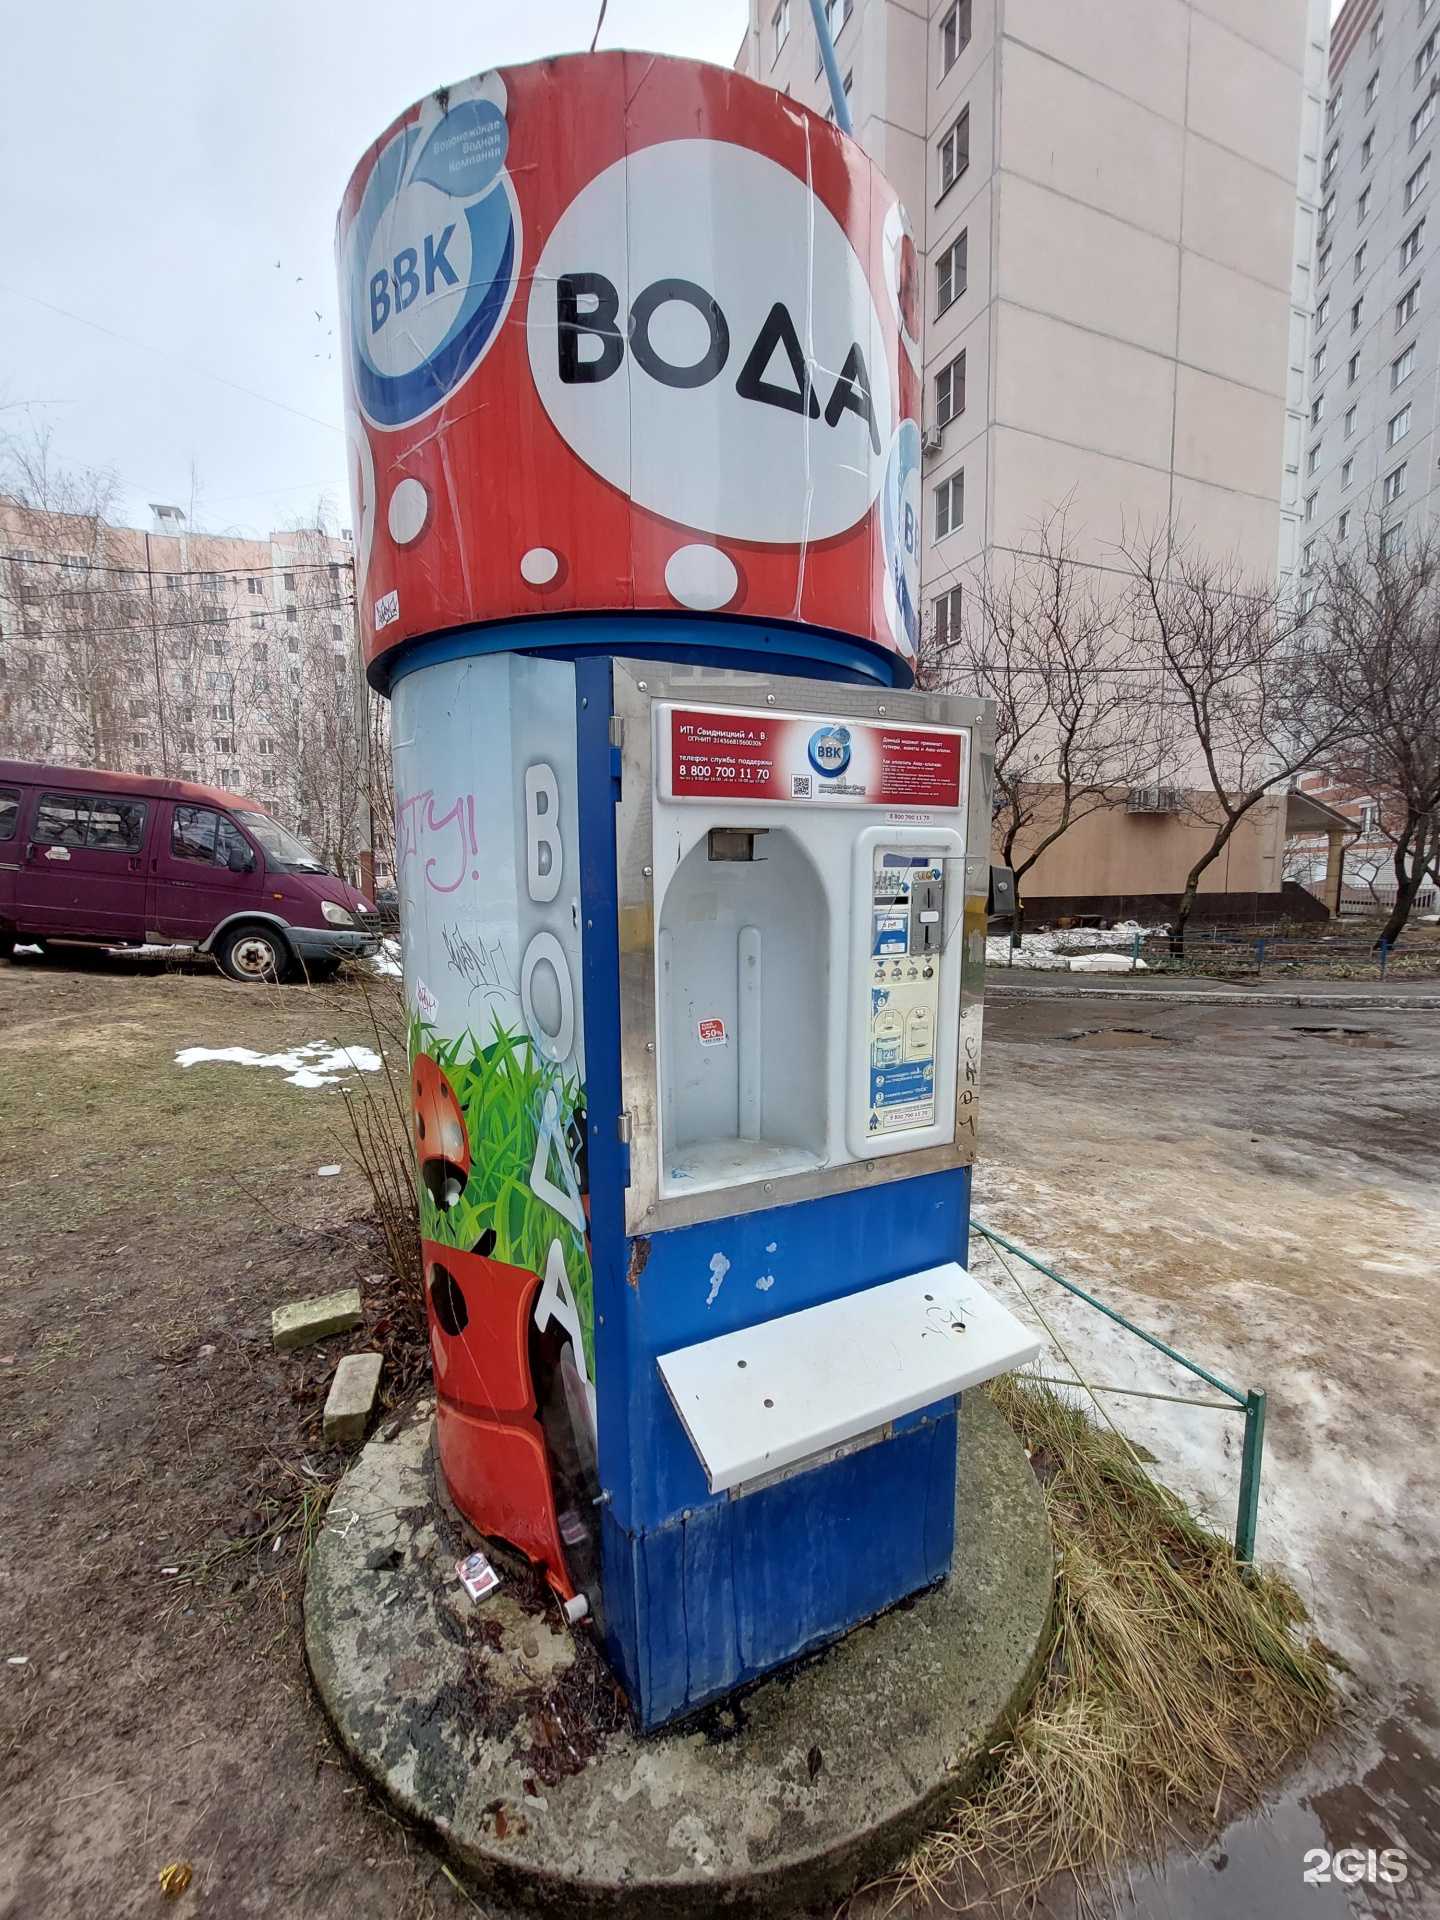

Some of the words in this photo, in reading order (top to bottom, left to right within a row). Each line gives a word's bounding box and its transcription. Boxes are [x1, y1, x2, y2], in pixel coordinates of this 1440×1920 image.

[369, 222, 461, 335] ВВК
[557, 272, 882, 456] ВОДА
[680, 725, 694, 734] ИП
[817, 746, 841, 758] ВВК
[710, 757, 736, 766] службы
[679, 765, 686, 775] 8
[691, 765, 711, 776] 800
[715, 767, 735, 777] 700
[740, 768, 751, 778] 11
[756, 769, 770, 779] 70
